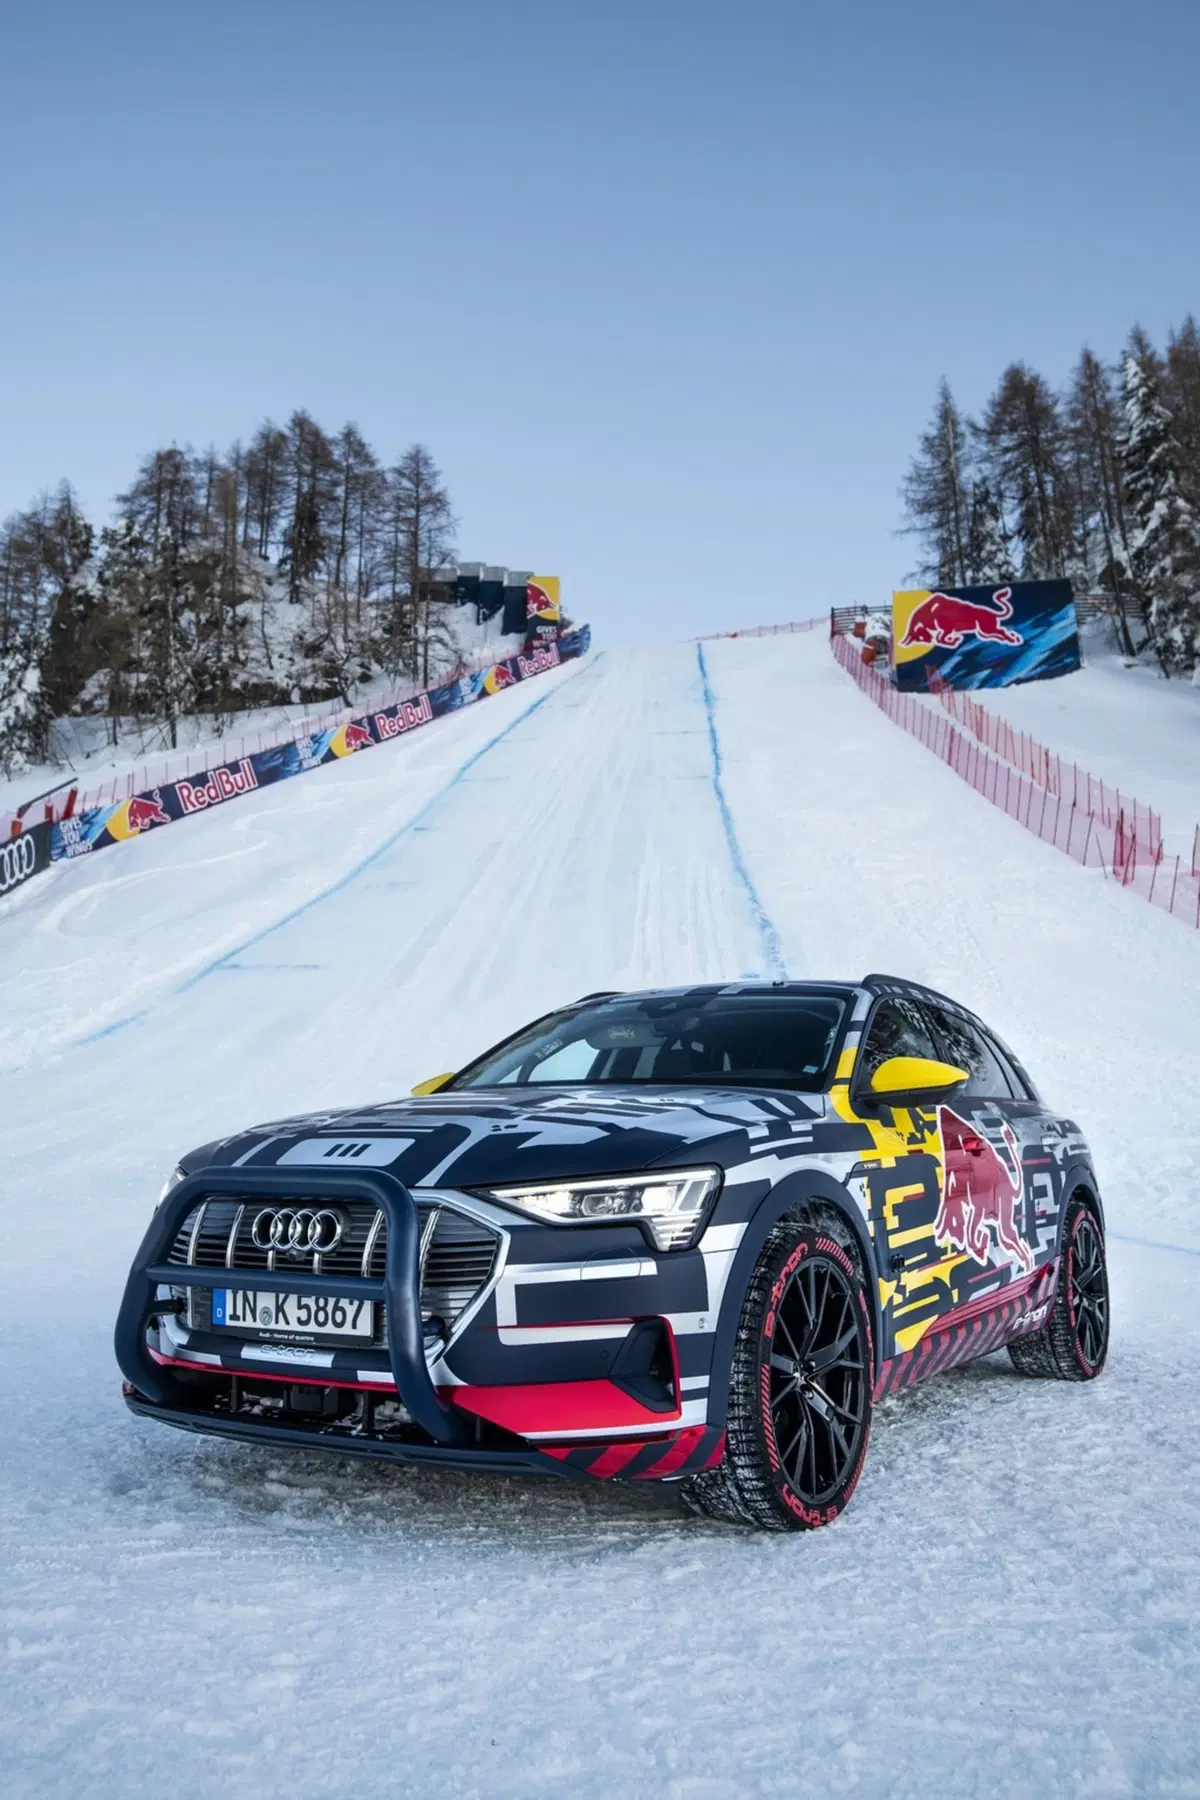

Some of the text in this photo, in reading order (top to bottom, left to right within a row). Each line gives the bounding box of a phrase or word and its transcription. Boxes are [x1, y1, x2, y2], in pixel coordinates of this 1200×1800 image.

[60, 815, 82, 833] GIVES
[63, 831, 80, 845] YOU
[66, 840, 93, 858] WINGS
[216, 1308, 223, 1318] D
[229, 1289, 365, 1330] IN K 5867
